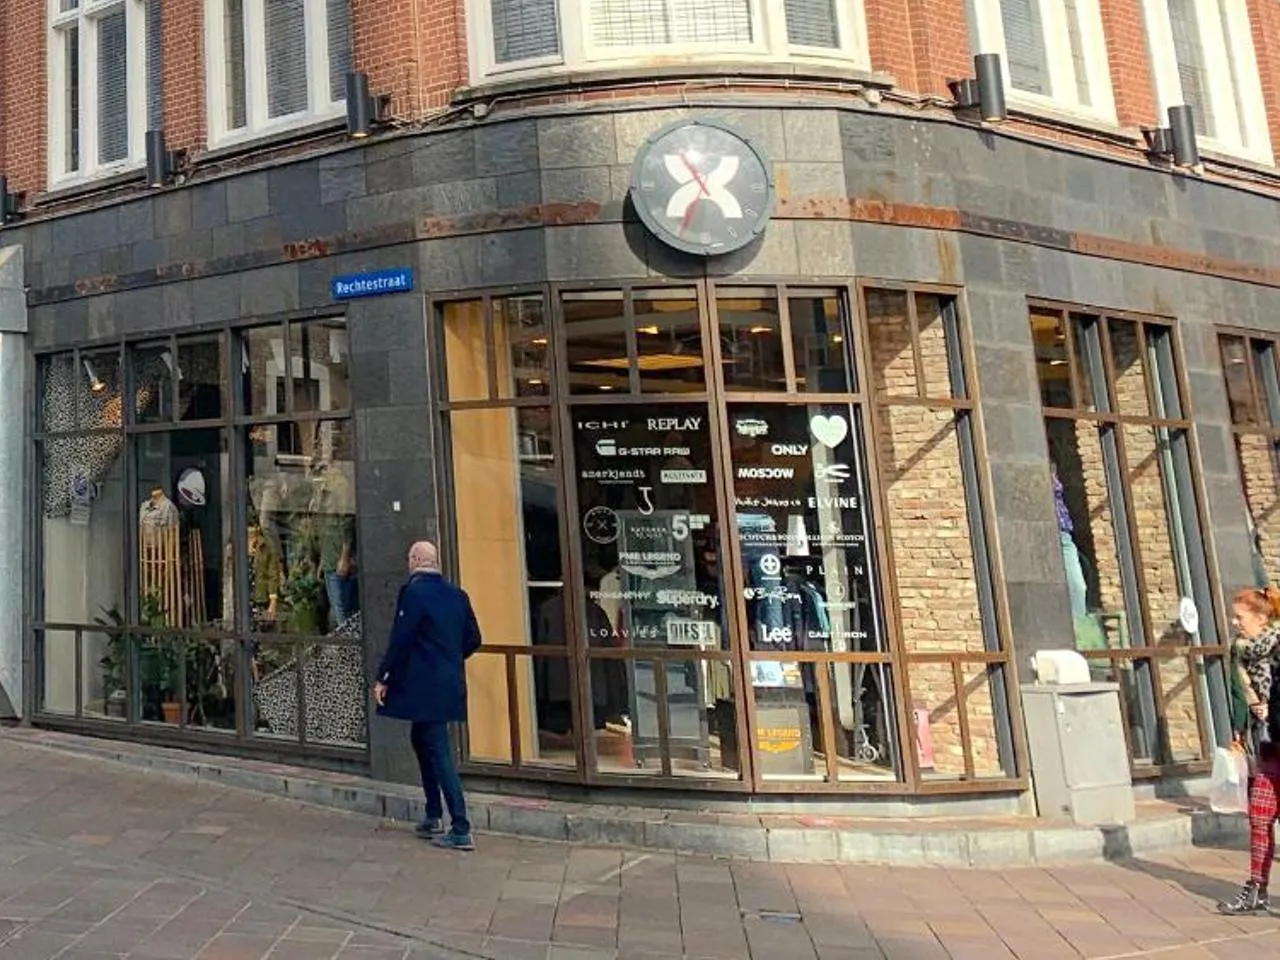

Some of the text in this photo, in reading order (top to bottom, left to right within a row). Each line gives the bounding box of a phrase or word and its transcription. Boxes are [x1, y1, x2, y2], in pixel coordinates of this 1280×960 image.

[335, 273, 406, 294] Rechtestraat
[647, 418, 701, 430] REPLAY
[618, 447, 691, 456] G-STAR RAW
[771, 444, 808, 455] ONLY
[760, 624, 793, 642] Lee
